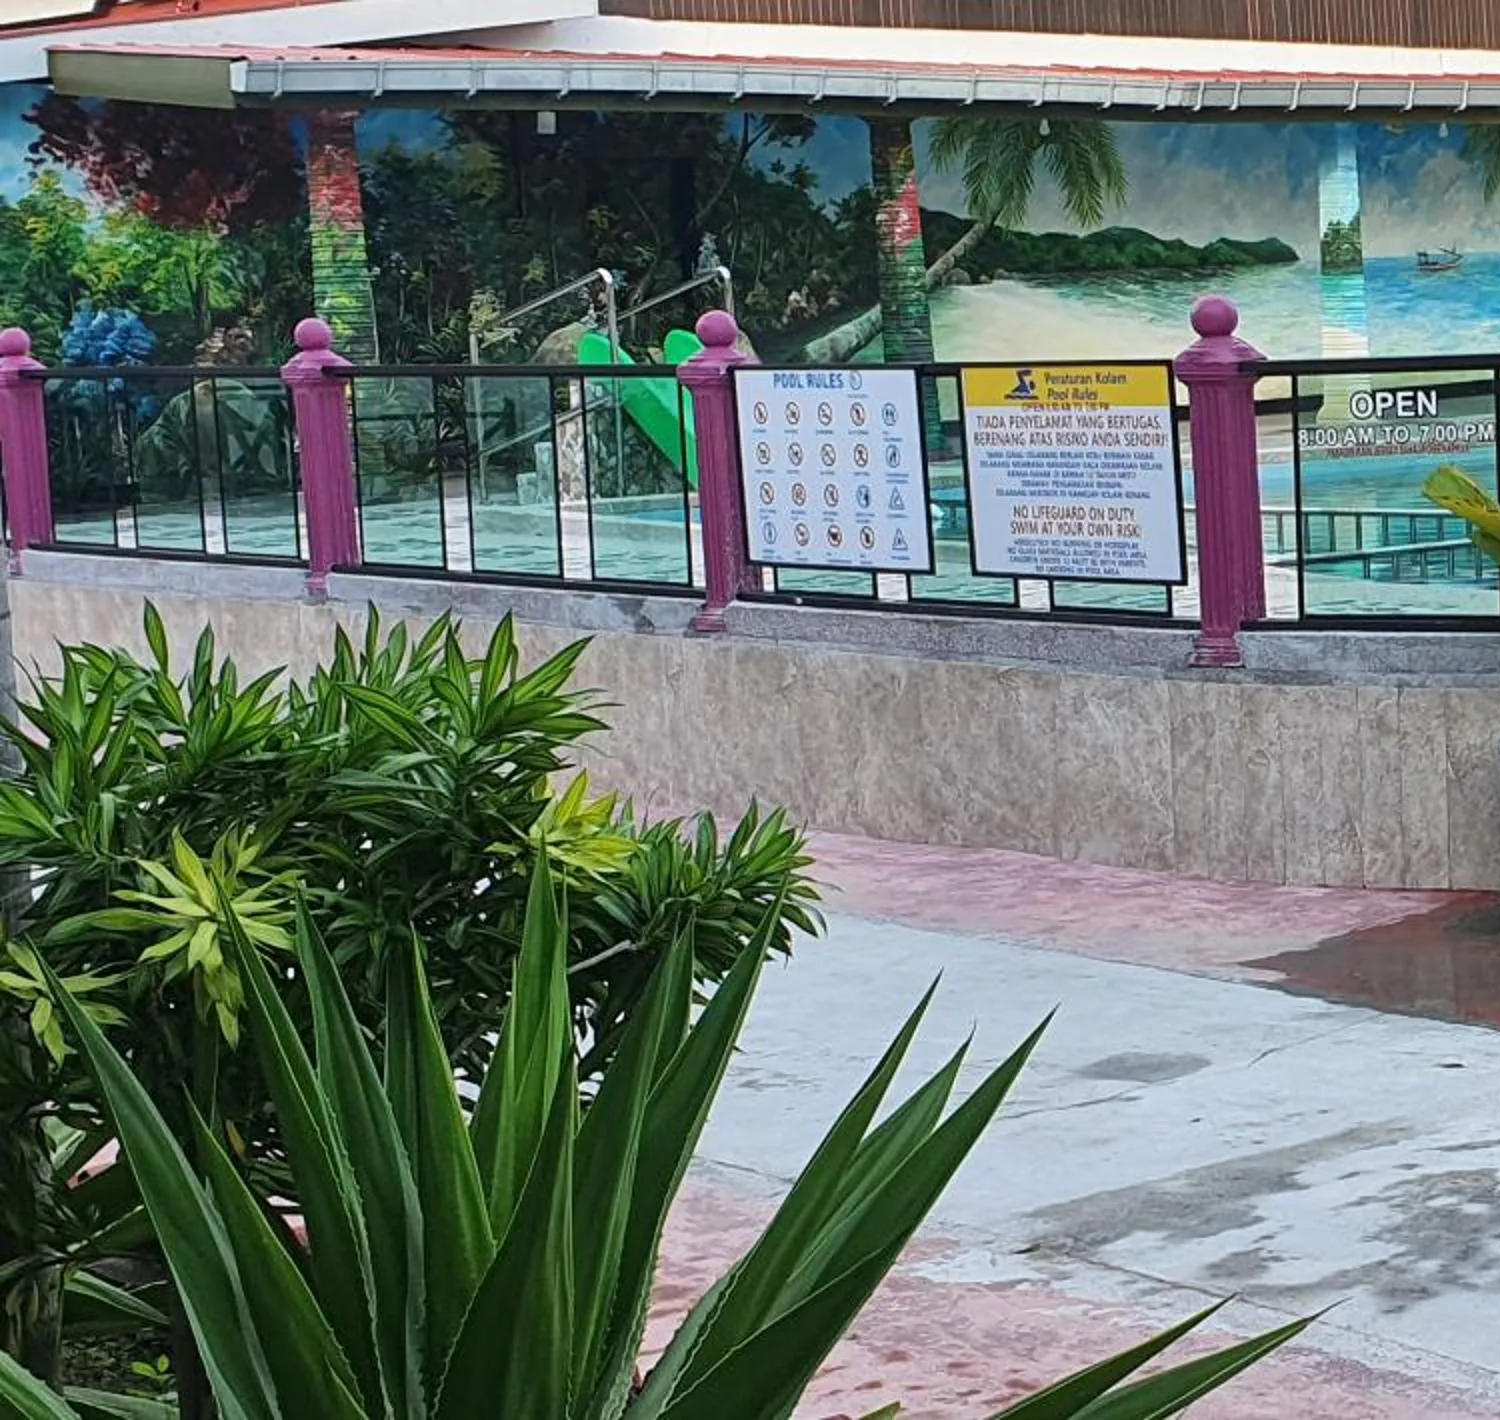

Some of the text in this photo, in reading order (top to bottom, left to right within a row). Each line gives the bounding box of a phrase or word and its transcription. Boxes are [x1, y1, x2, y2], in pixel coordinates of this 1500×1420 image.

[773, 373, 844, 389] POOL RULES
[1096, 371, 1127, 384] Kolam
[1047, 388, 1098, 400] Pool Rules
[1351, 390, 1438, 418] OPEN
[1009, 416, 1072, 429] PENYELAMAT
[1076, 416, 1104, 429] YANG
[973, 432, 1025, 446] BERENANG
[1029, 432, 1051, 446] ATAS
[1055, 432, 1089, 446] RISIKO
[1091, 433, 1120, 446] ANDA
[1343, 426, 1375, 445] AM
[1383, 424, 1410, 443] TO
[1464, 423, 1495, 442] PM
[1013, 505, 1029, 519] NO
[1031, 505, 1087, 521] LIFEGUARD
[1088, 506, 1106, 521] ON
[1010, 521, 1039, 535] SWIM
[1041, 521, 1055, 535] AT
[1057, 522, 1085, 536] YOUR
[1087, 522, 1114, 537] OWN
